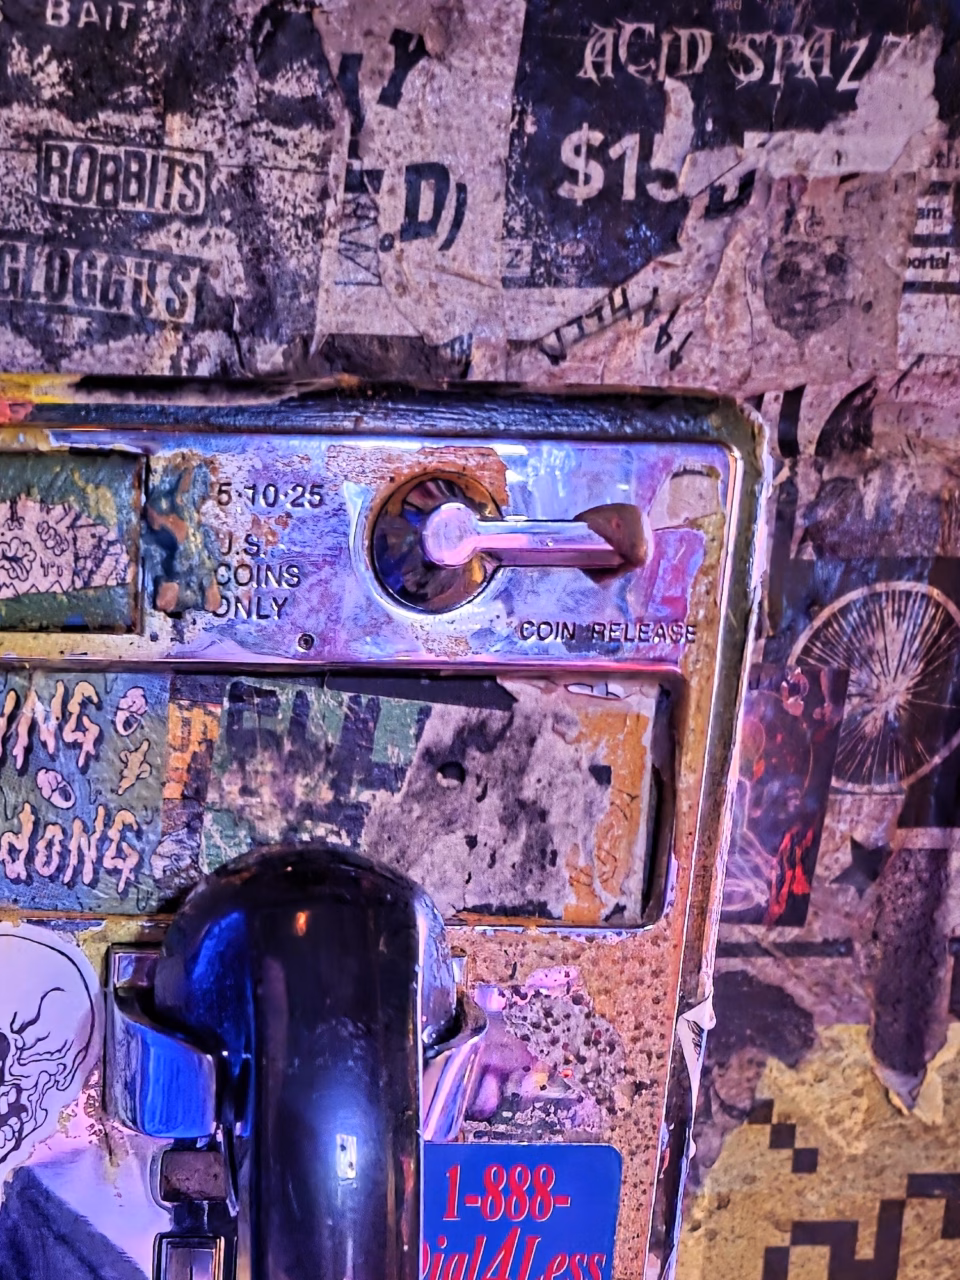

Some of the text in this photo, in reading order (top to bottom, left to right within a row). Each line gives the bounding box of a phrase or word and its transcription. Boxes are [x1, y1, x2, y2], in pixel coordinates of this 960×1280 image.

[46, 0, 135, 30] BAIT
[576, 17, 713, 86] ACID
[215, 562, 301, 588] COINS
[212, 595, 289, 620] ONLY
[519, 619, 696, 645] COIN RELEASE
[442, 1162, 571, 1223] 1-888-
